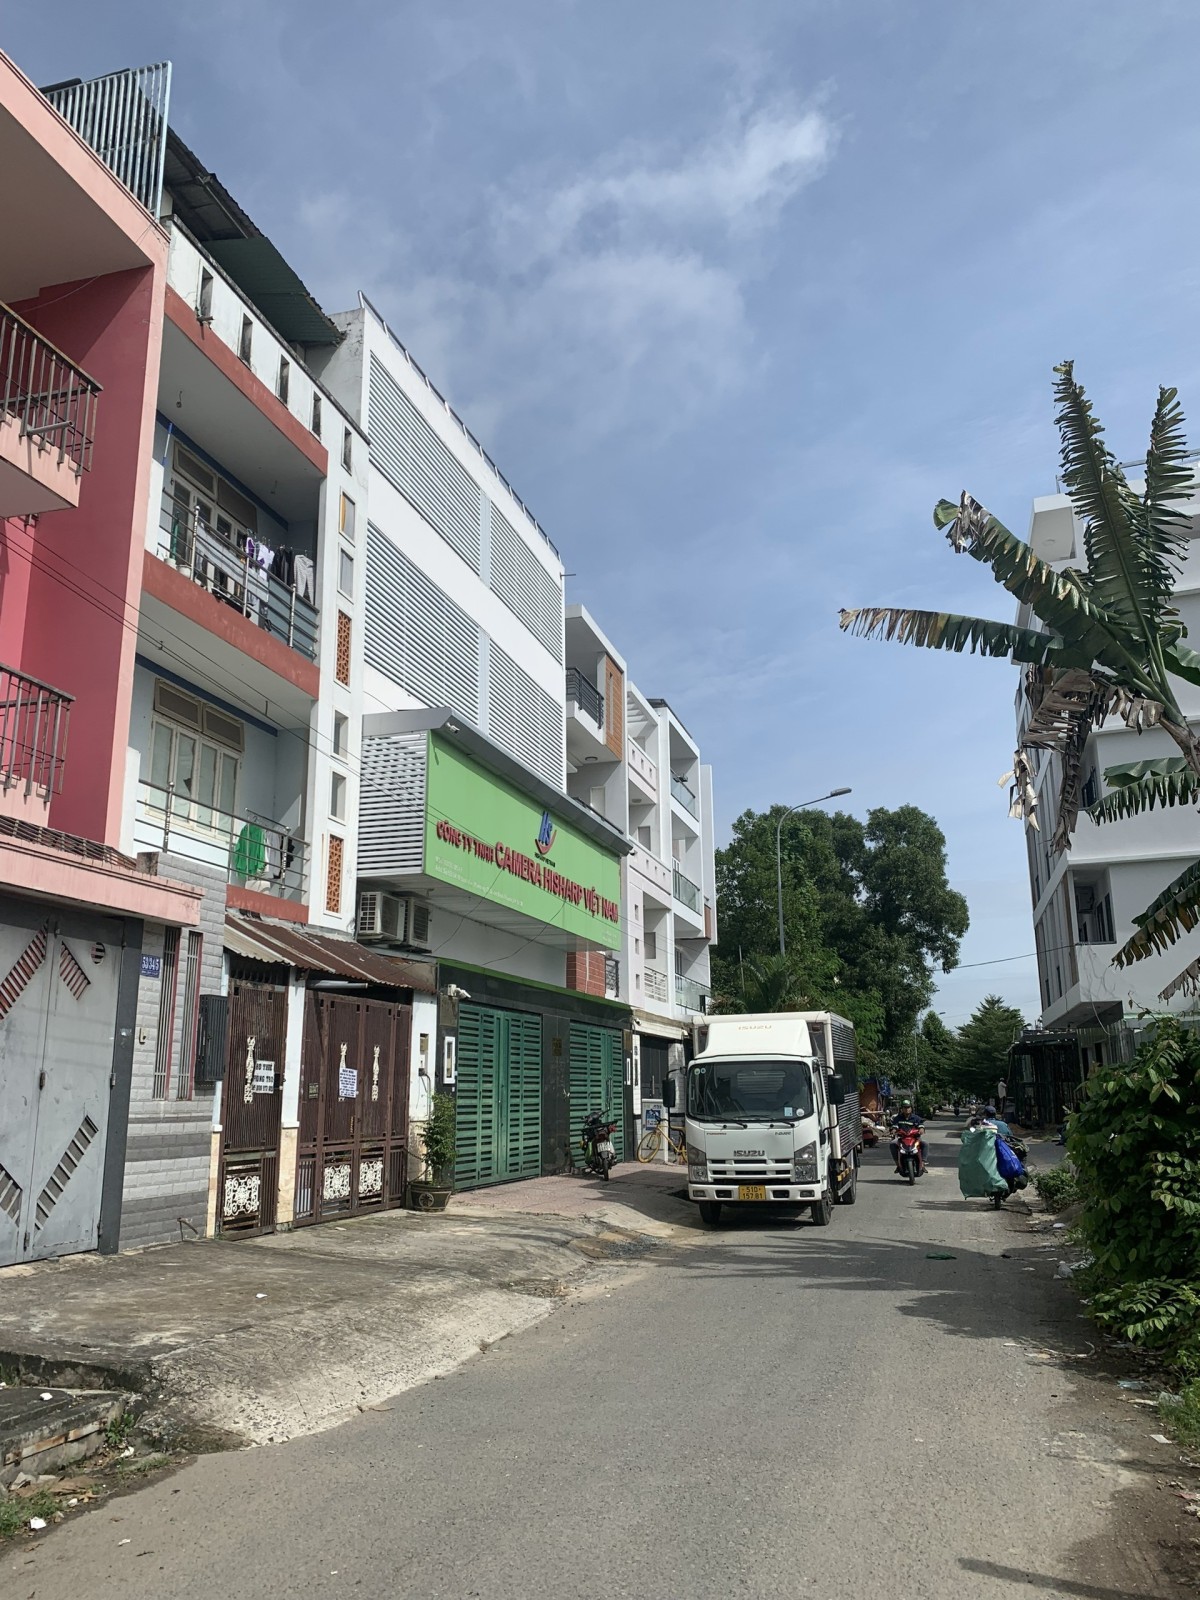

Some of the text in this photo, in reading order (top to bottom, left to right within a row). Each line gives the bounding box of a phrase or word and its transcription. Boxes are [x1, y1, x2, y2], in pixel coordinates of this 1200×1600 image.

[437, 820, 462, 848] CÔNG
[462, 833, 473, 854] TY
[474, 840, 495, 865] TNHH
[495, 841, 542, 886] CAMERA
[543, 867, 583, 906] HISHARP
[583, 886, 602, 917] VIỆT
[602, 897, 619, 924] NAM
